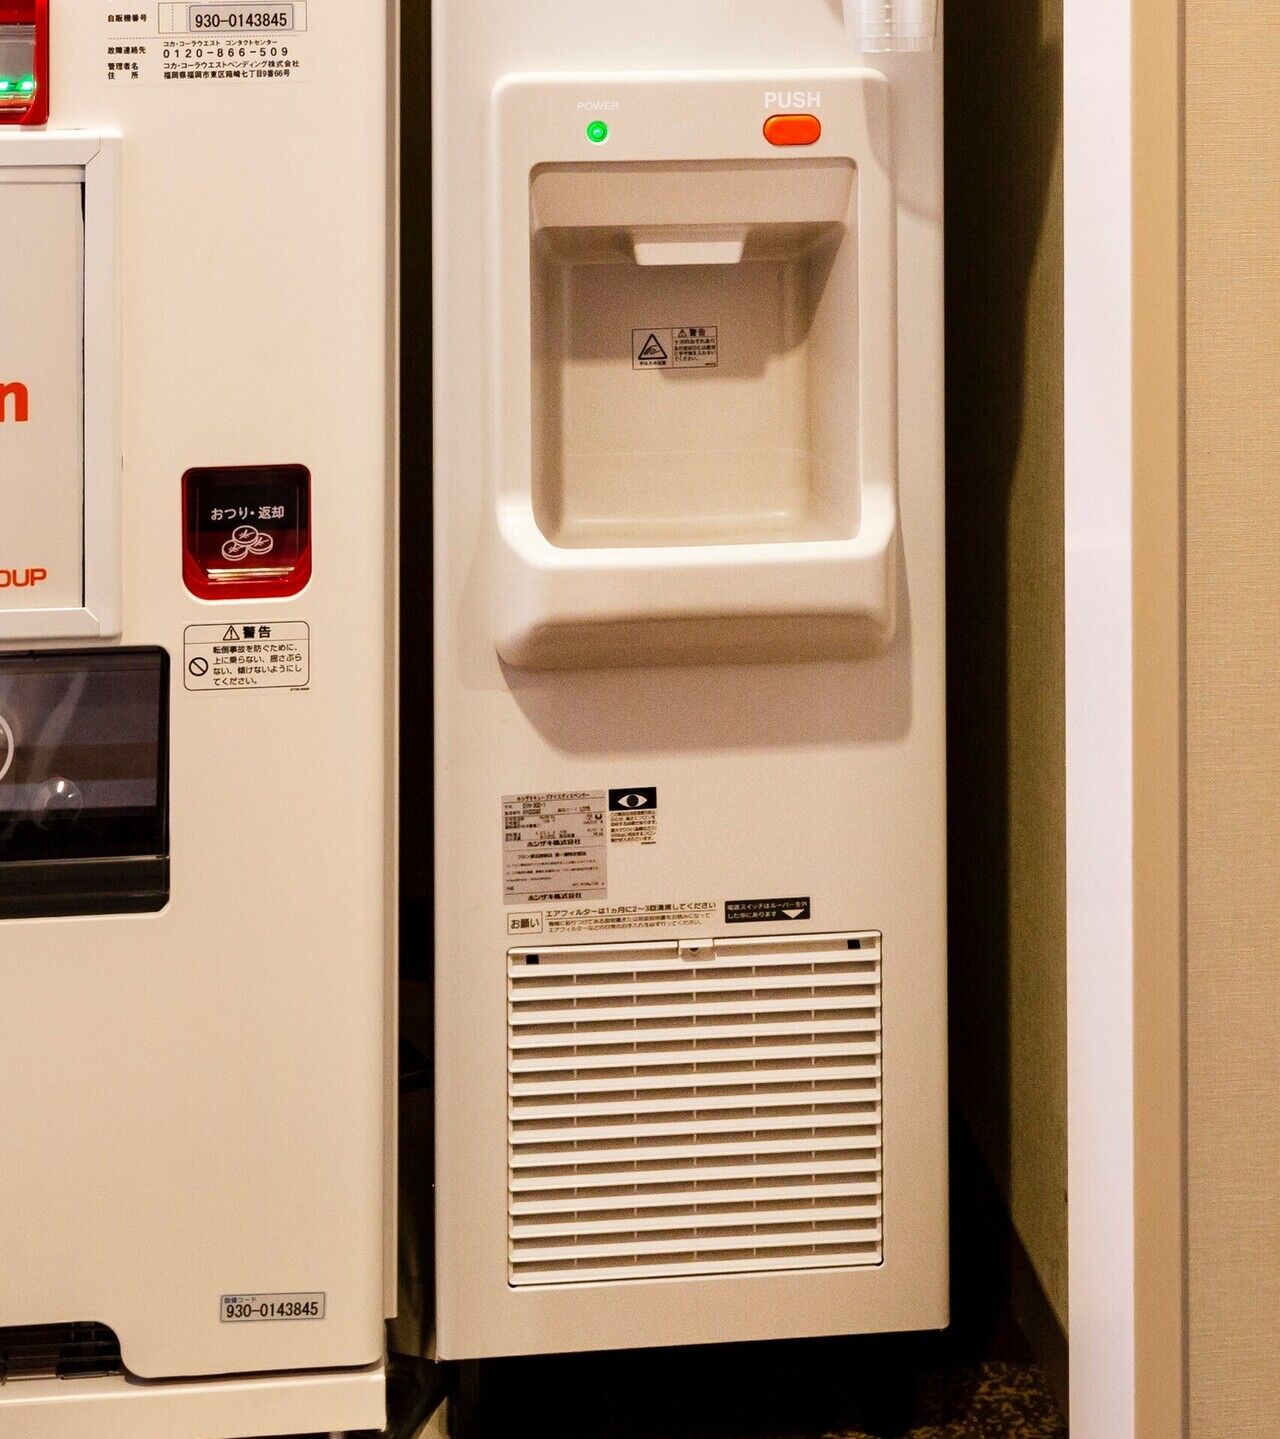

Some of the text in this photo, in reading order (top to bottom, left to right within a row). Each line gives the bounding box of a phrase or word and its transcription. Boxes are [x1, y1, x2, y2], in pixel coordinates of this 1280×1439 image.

[107, 13, 288, 28] 自販機番号 930-0143845
[225, 39, 278, 47] コンタクトセンター
[107, 46, 147, 55] 故障連絡先
[107, 62, 139, 71] 管理者名
[763, 91, 821, 109] PUSH
[577, 101, 620, 111] POWER
[210, 505, 285, 521] おつり・返却
[242, 625, 272, 639] 警告
[212, 665, 303, 675] ない、傾けないようにし
[212, 676, 259, 686] てください。
[510, 916, 541, 929] お願い
[226, 1301, 319, 1318] 930-0143845
